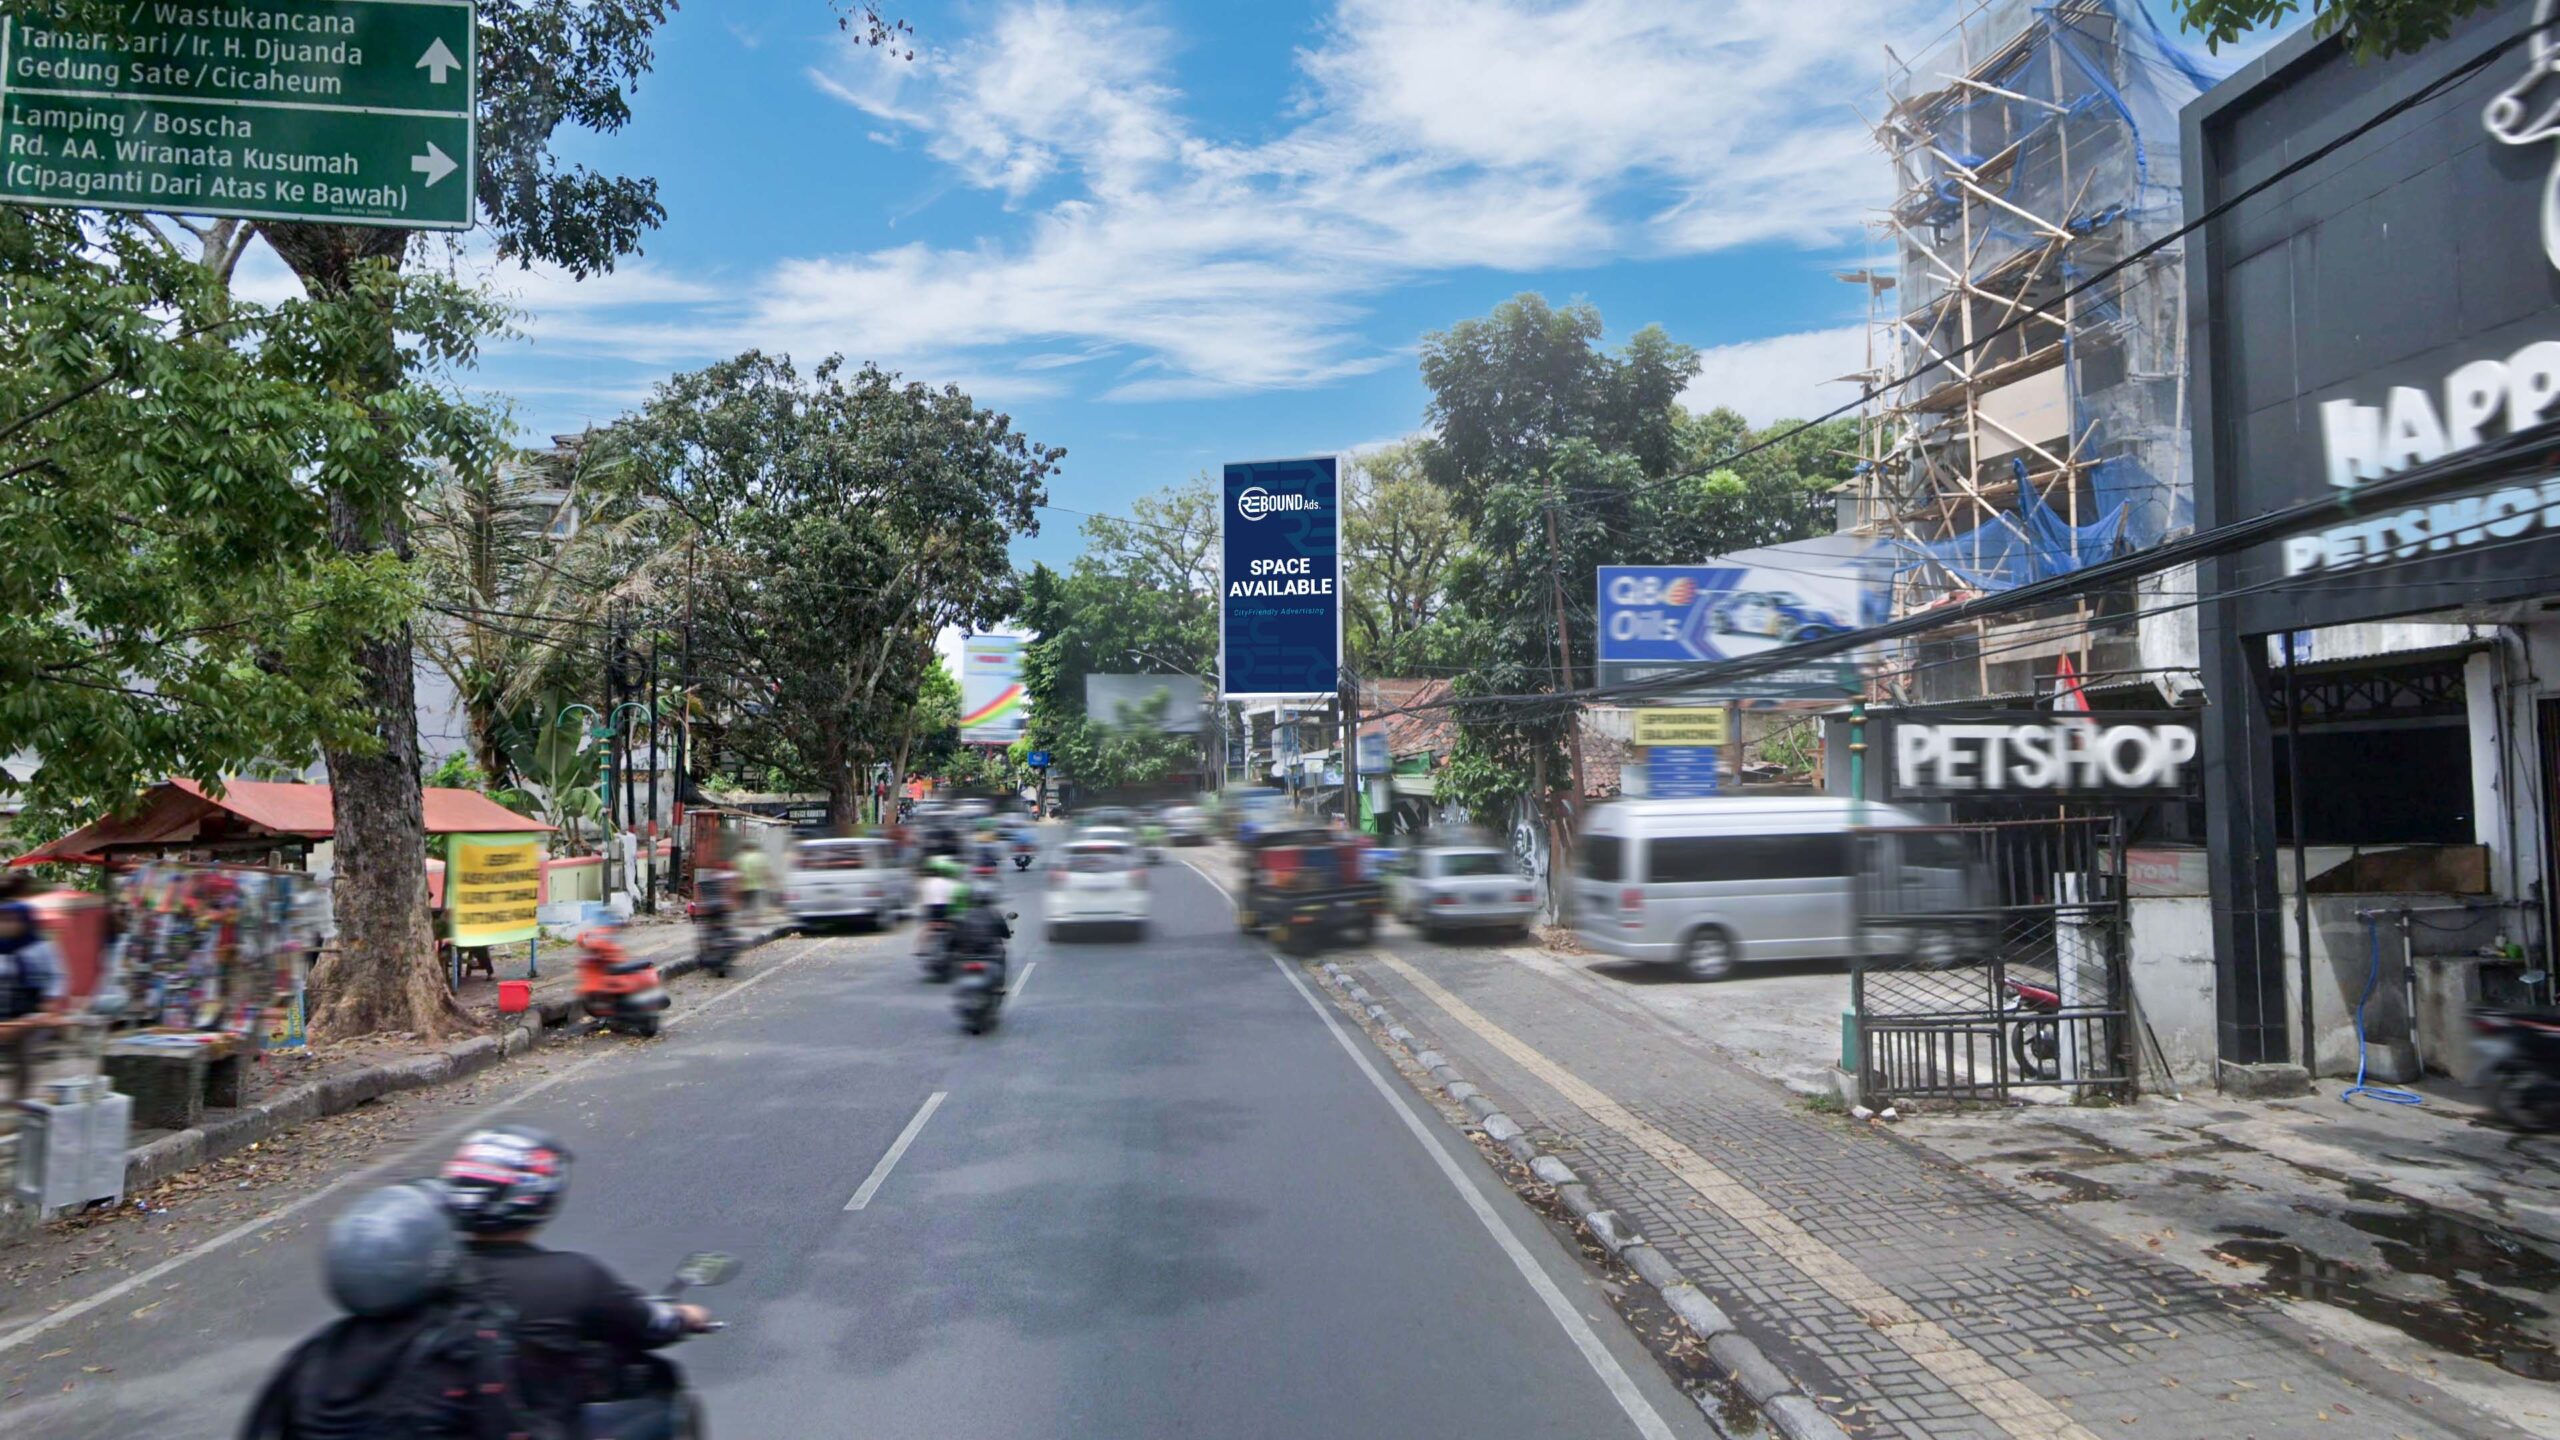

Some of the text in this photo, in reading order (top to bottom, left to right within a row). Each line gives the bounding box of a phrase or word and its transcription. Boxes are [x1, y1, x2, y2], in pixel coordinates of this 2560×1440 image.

[154, 3, 355, 34] Wastukancana
[21, 26, 109, 50] Taman
[224, 36, 246, 59] H.
[256, 38, 363, 66] Djuanda
[17, 56, 119, 87] Gedung
[130, 63, 190, 86] Sate
[12, 105, 125, 137] Lamping
[154, 113, 252, 138] Boscha
[10, 134, 359, 175] Rd. AA. Wiranata Kusumah
[7, 161, 142, 195] (Cipaganti
[151, 173, 202, 196] Dari
[210, 176, 267, 199] Atas
[275, 181, 305, 202] Ke
[312, 182, 407, 212] Bawah)
[1250, 558, 1311, 575] SPACE
[1229, 578, 1333, 597] AVAILABLE
[1280, 607, 1325, 616] Advertising
[1610, 609, 1681, 641] Oils
[1896, 724, 2198, 789] PETSHOP
